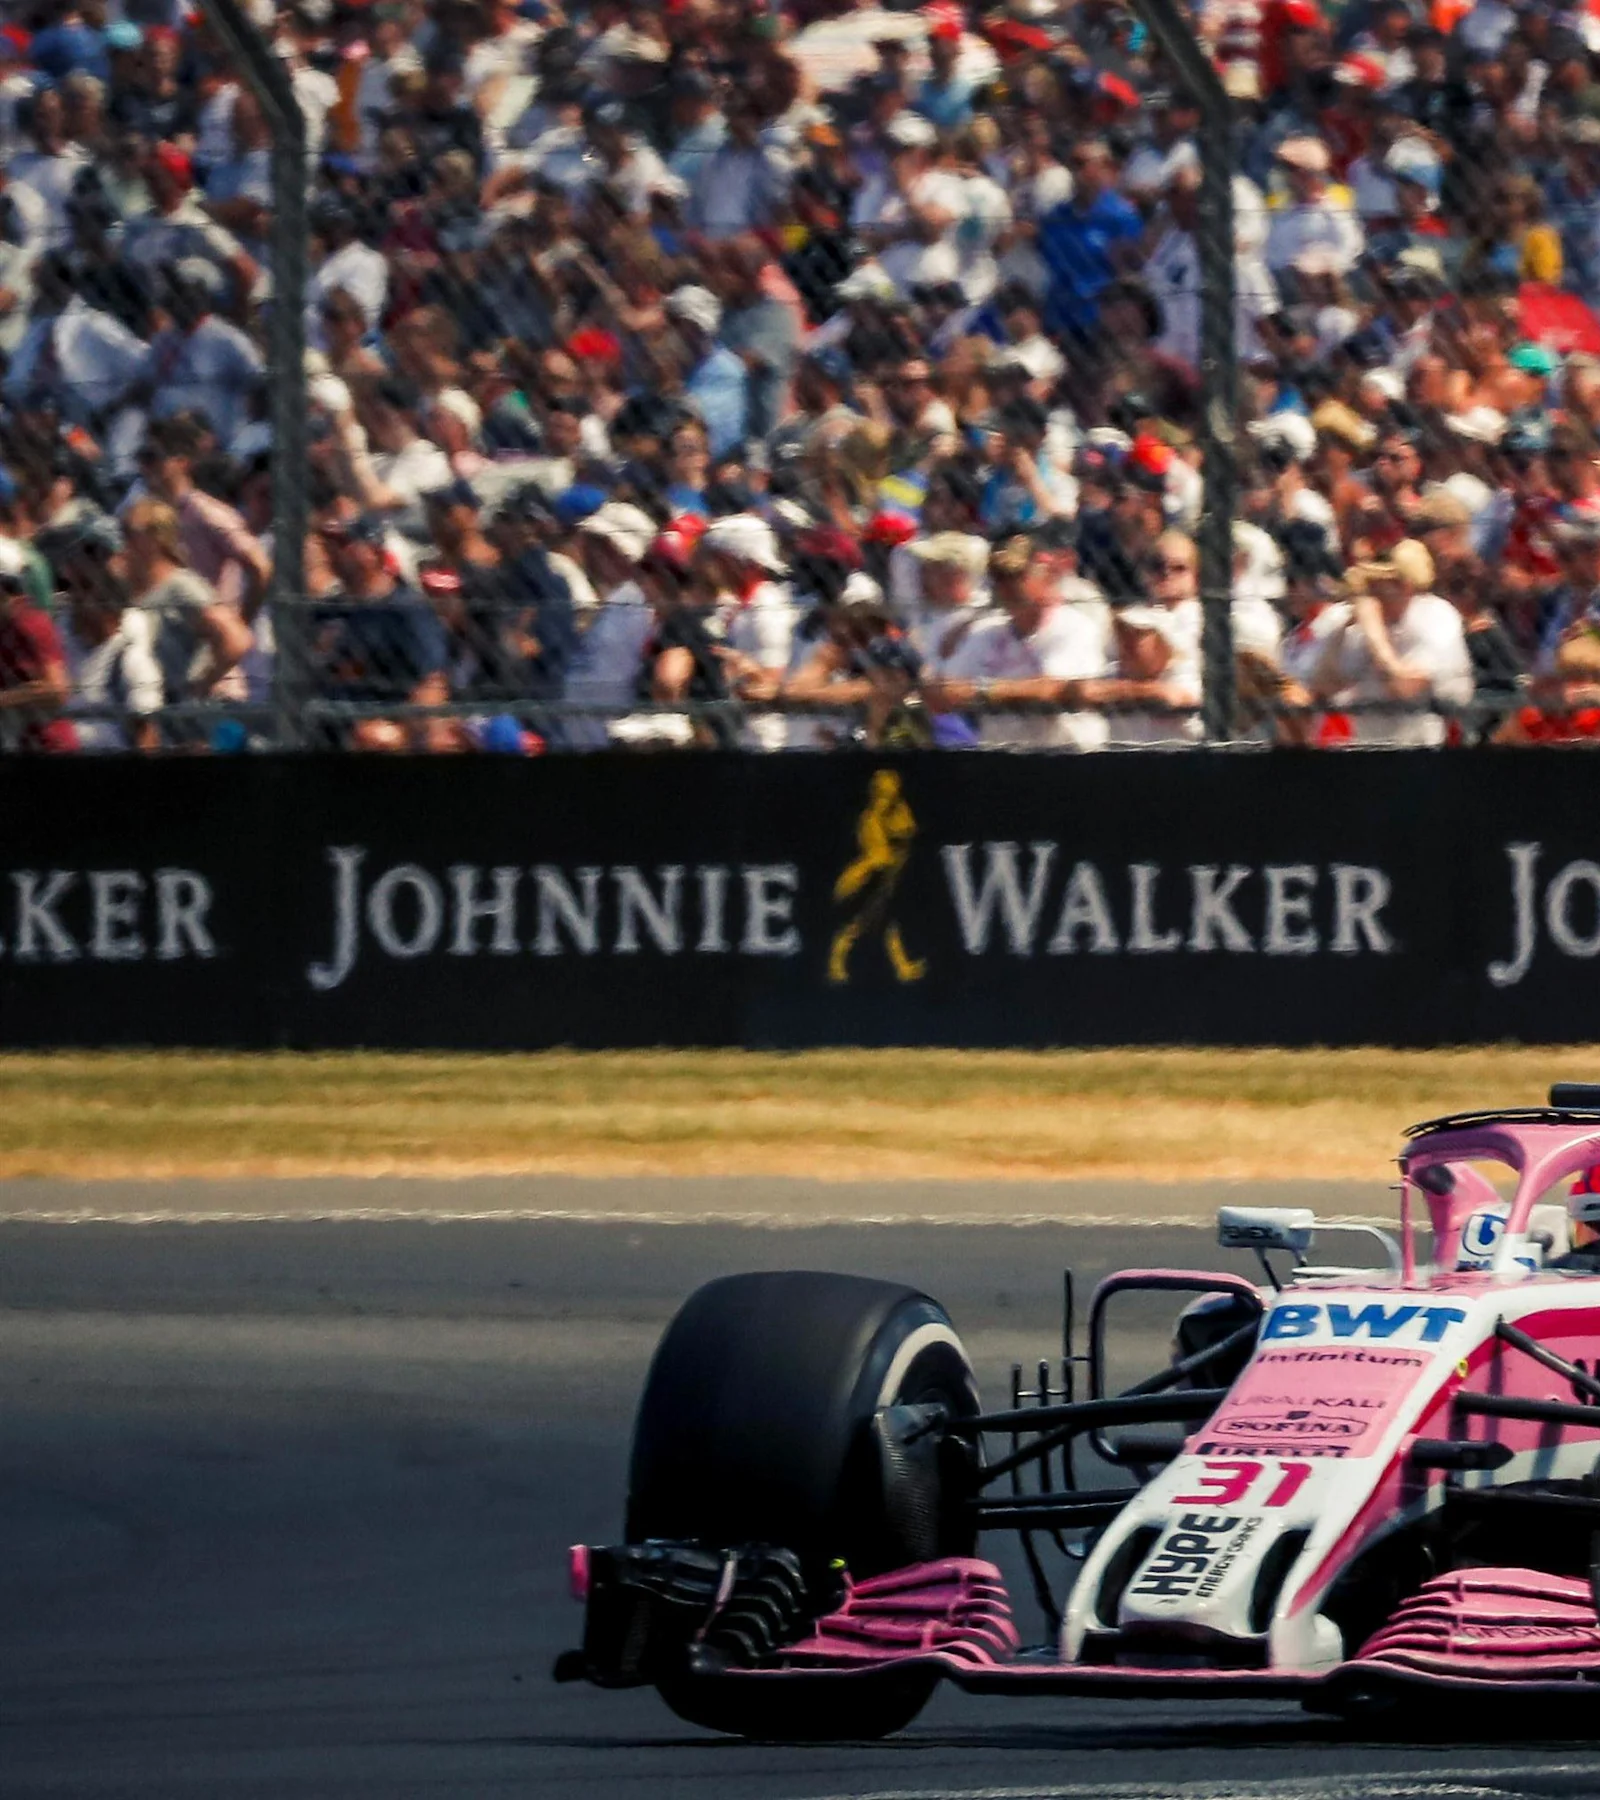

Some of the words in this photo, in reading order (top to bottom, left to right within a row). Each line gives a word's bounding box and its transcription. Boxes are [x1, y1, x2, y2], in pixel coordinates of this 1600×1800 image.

[0, 868, 213, 959] KER
[308, 845, 798, 989] JOHNNIE
[943, 841, 1391, 955] WALKER
[1261, 1304, 1467, 1342] BWT
[1227, 1421, 1353, 1434] SOFINA
[1171, 1462, 1312, 1507] 31
[1130, 1514, 1243, 1596] HYPE
